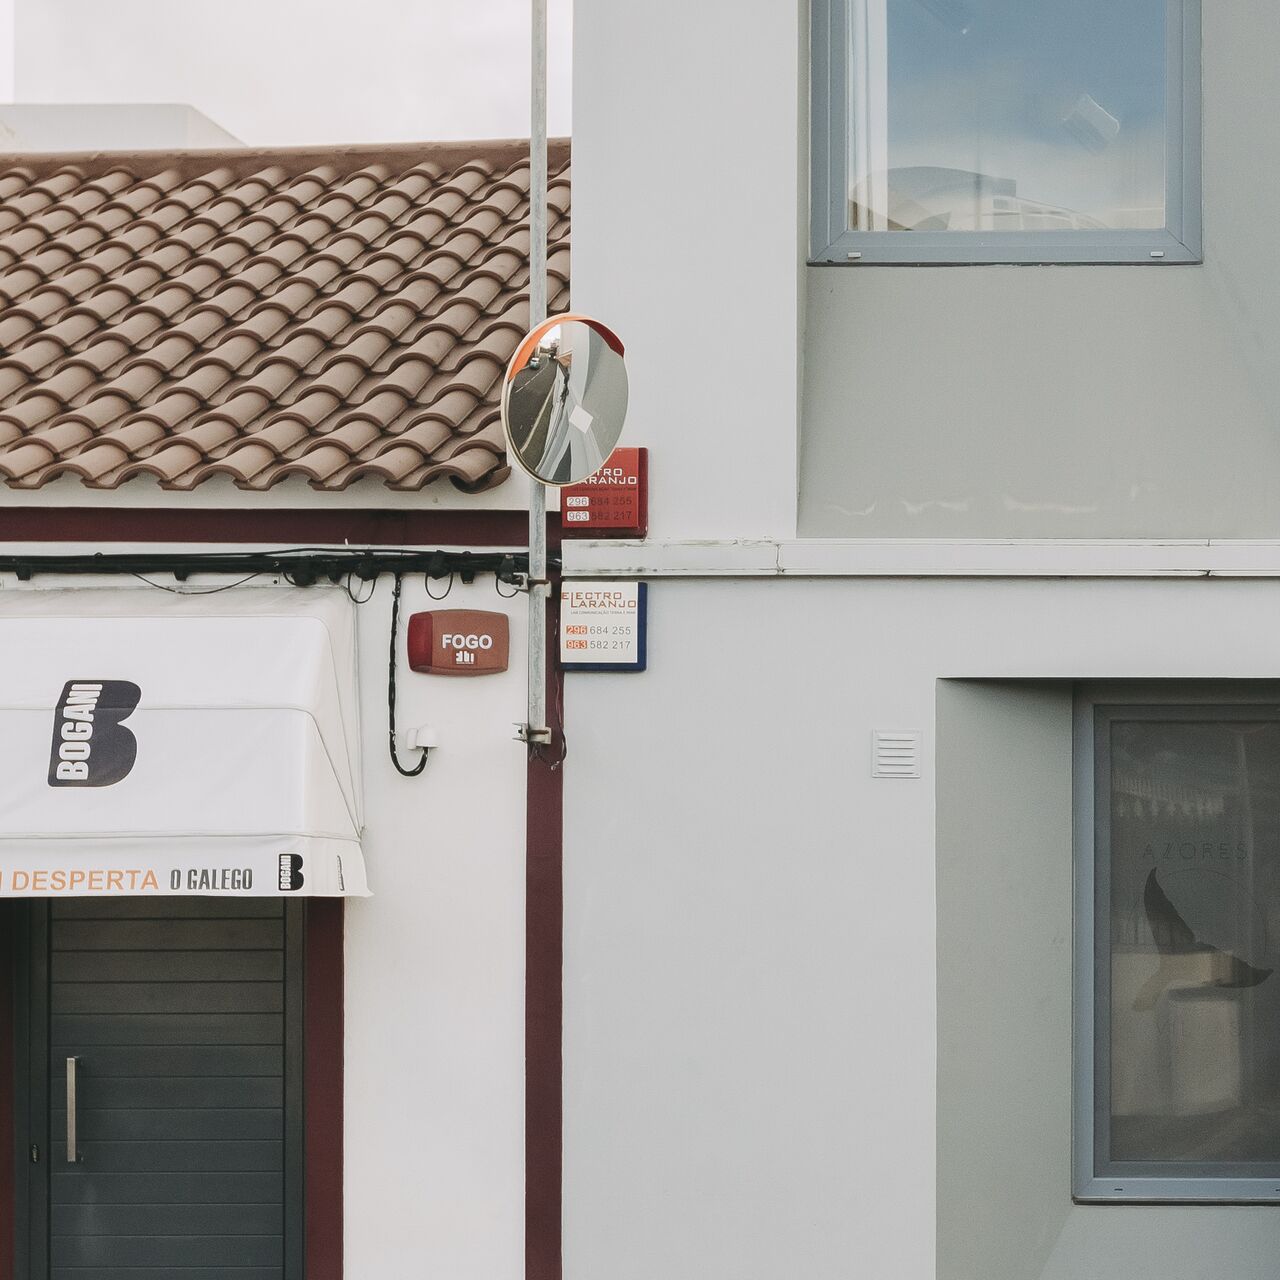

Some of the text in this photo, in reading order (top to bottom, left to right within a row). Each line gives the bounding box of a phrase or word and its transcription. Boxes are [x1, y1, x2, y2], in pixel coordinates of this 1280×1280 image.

[568, 497, 588, 506] 296
[568, 511, 588, 520] 963
[613, 511, 632, 520] 217
[561, 592, 622, 600] ELECTRO
[570, 598, 637, 608] LARANJO
[567, 626, 631, 635] 296 684 255
[442, 634, 493, 649] FOGO
[567, 640, 631, 649] 963 582 217
[56, 683, 103, 780] BOGANI
[1142, 842, 1248, 860] AZORES
[280, 855, 292, 890] BOGANI
[12, 870, 159, 891] DESPERTA
[169, 869, 182, 890] O
[187, 869, 252, 890] GALEGO
